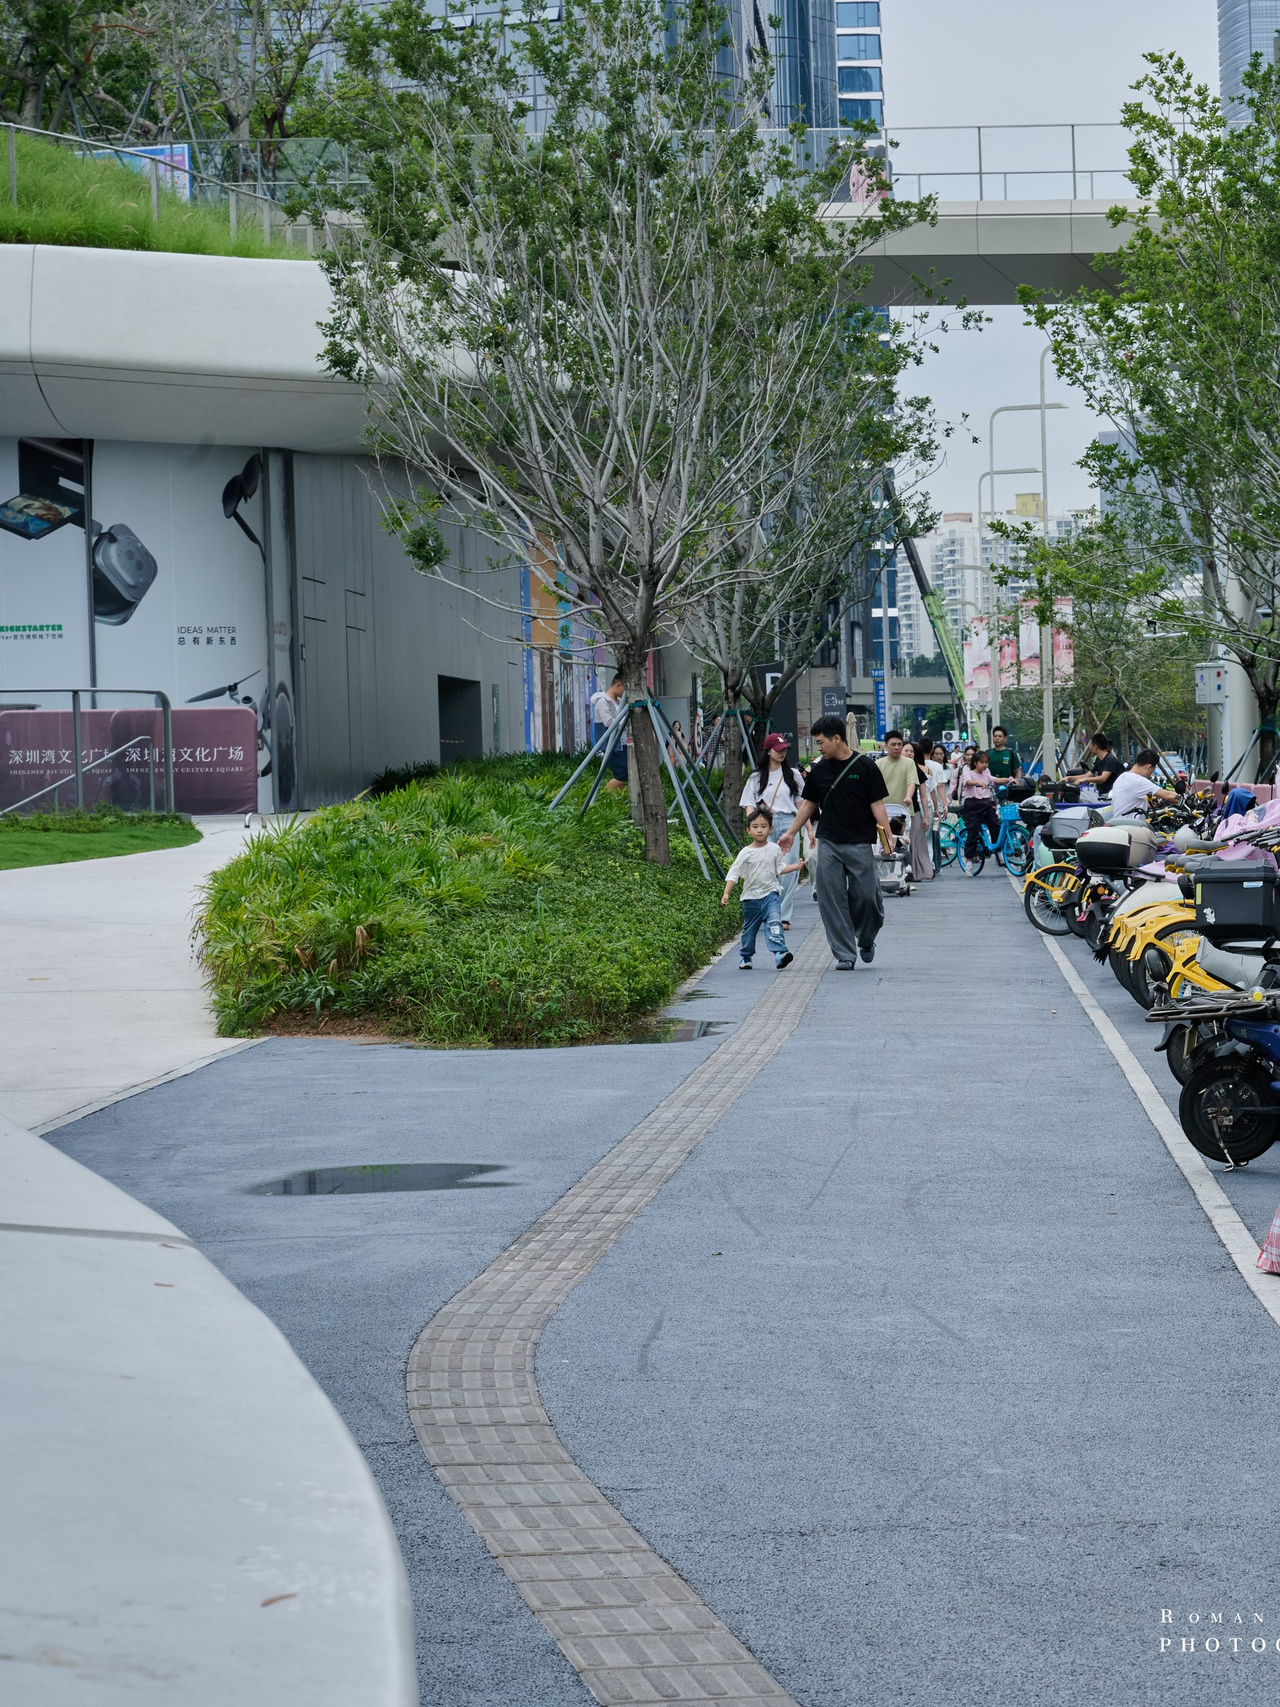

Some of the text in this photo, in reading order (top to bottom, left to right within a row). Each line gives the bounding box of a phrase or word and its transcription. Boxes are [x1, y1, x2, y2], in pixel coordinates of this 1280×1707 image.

[177, 626, 237, 634] IDEAS MATTER
[178, 637, 237, 645] 总有新东西
